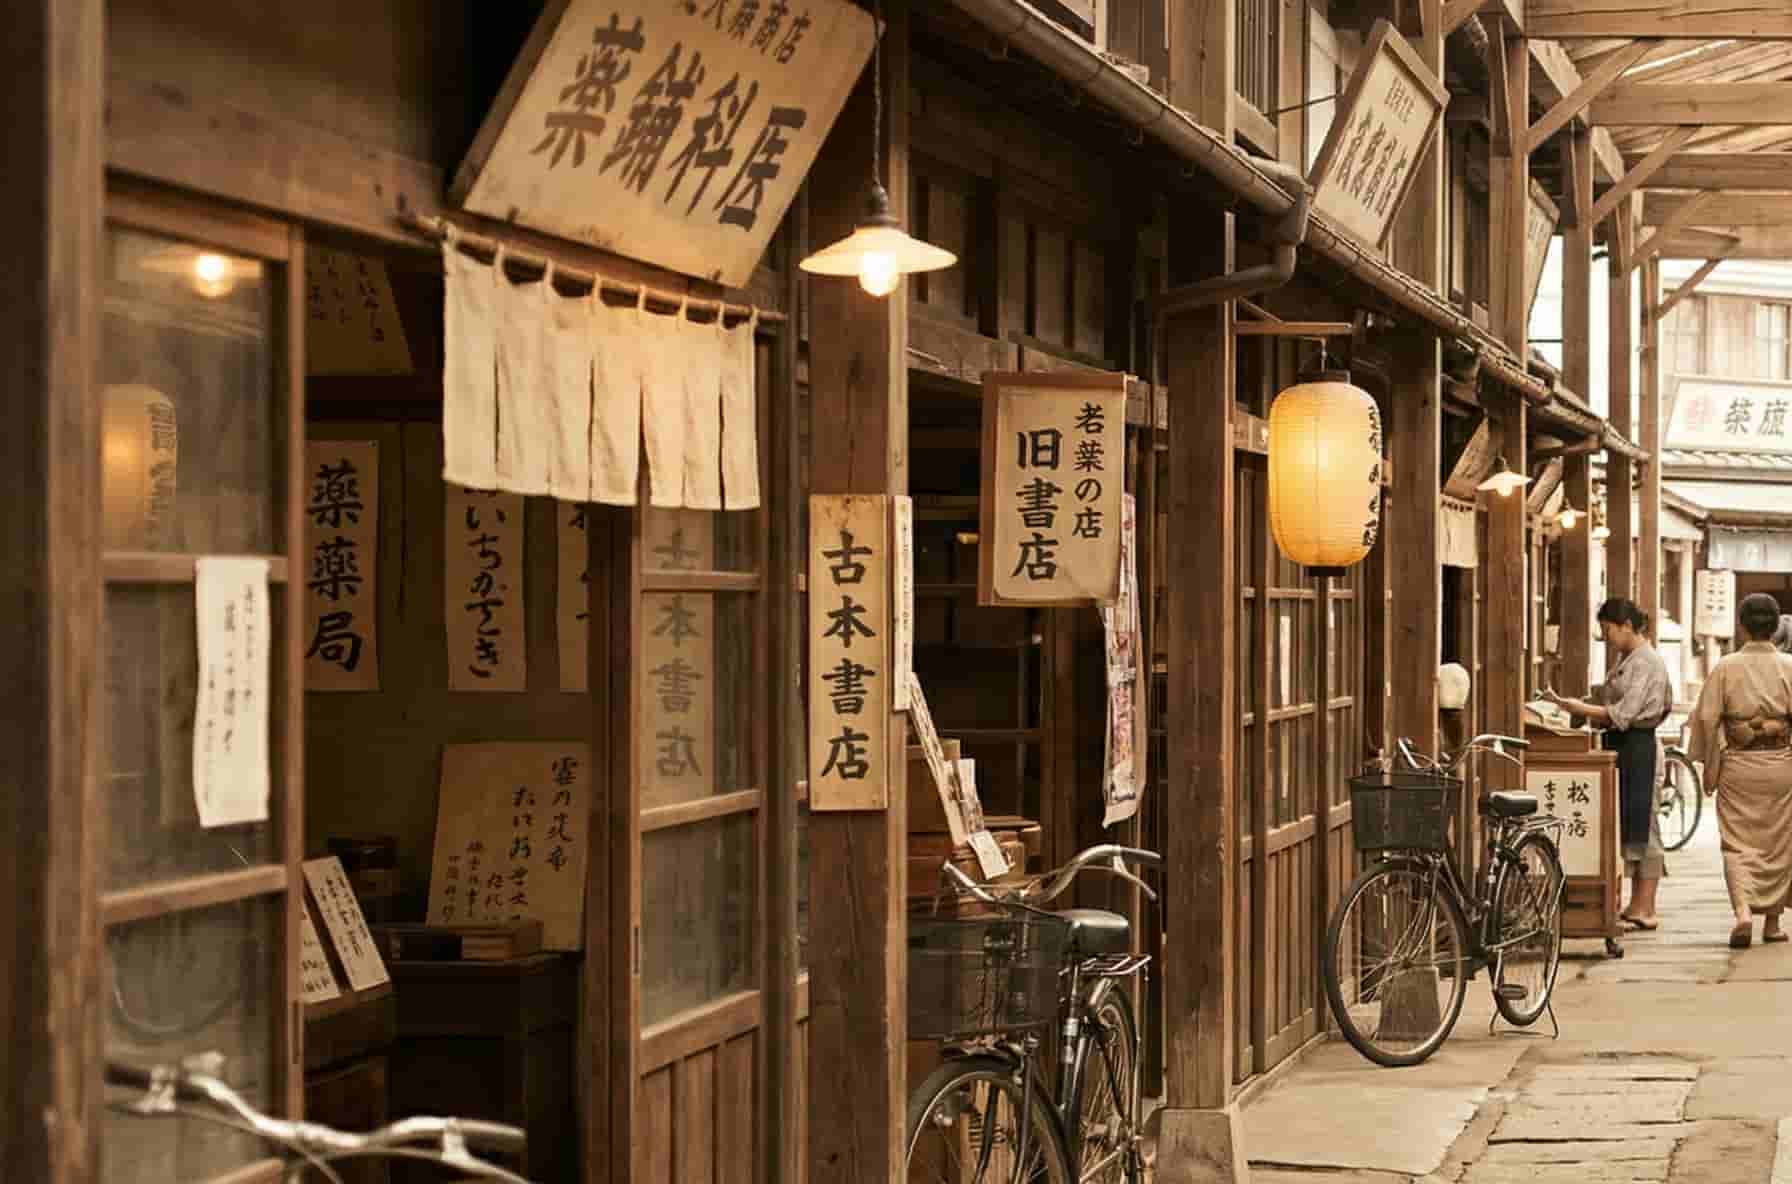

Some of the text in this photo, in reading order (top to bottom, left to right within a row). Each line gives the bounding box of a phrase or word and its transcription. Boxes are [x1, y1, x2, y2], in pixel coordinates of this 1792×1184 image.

[1011, 428, 1063, 580] 旧書店
[1072, 402, 1105, 539] 若葉の店
[820, 529, 876, 781] 古本書店
